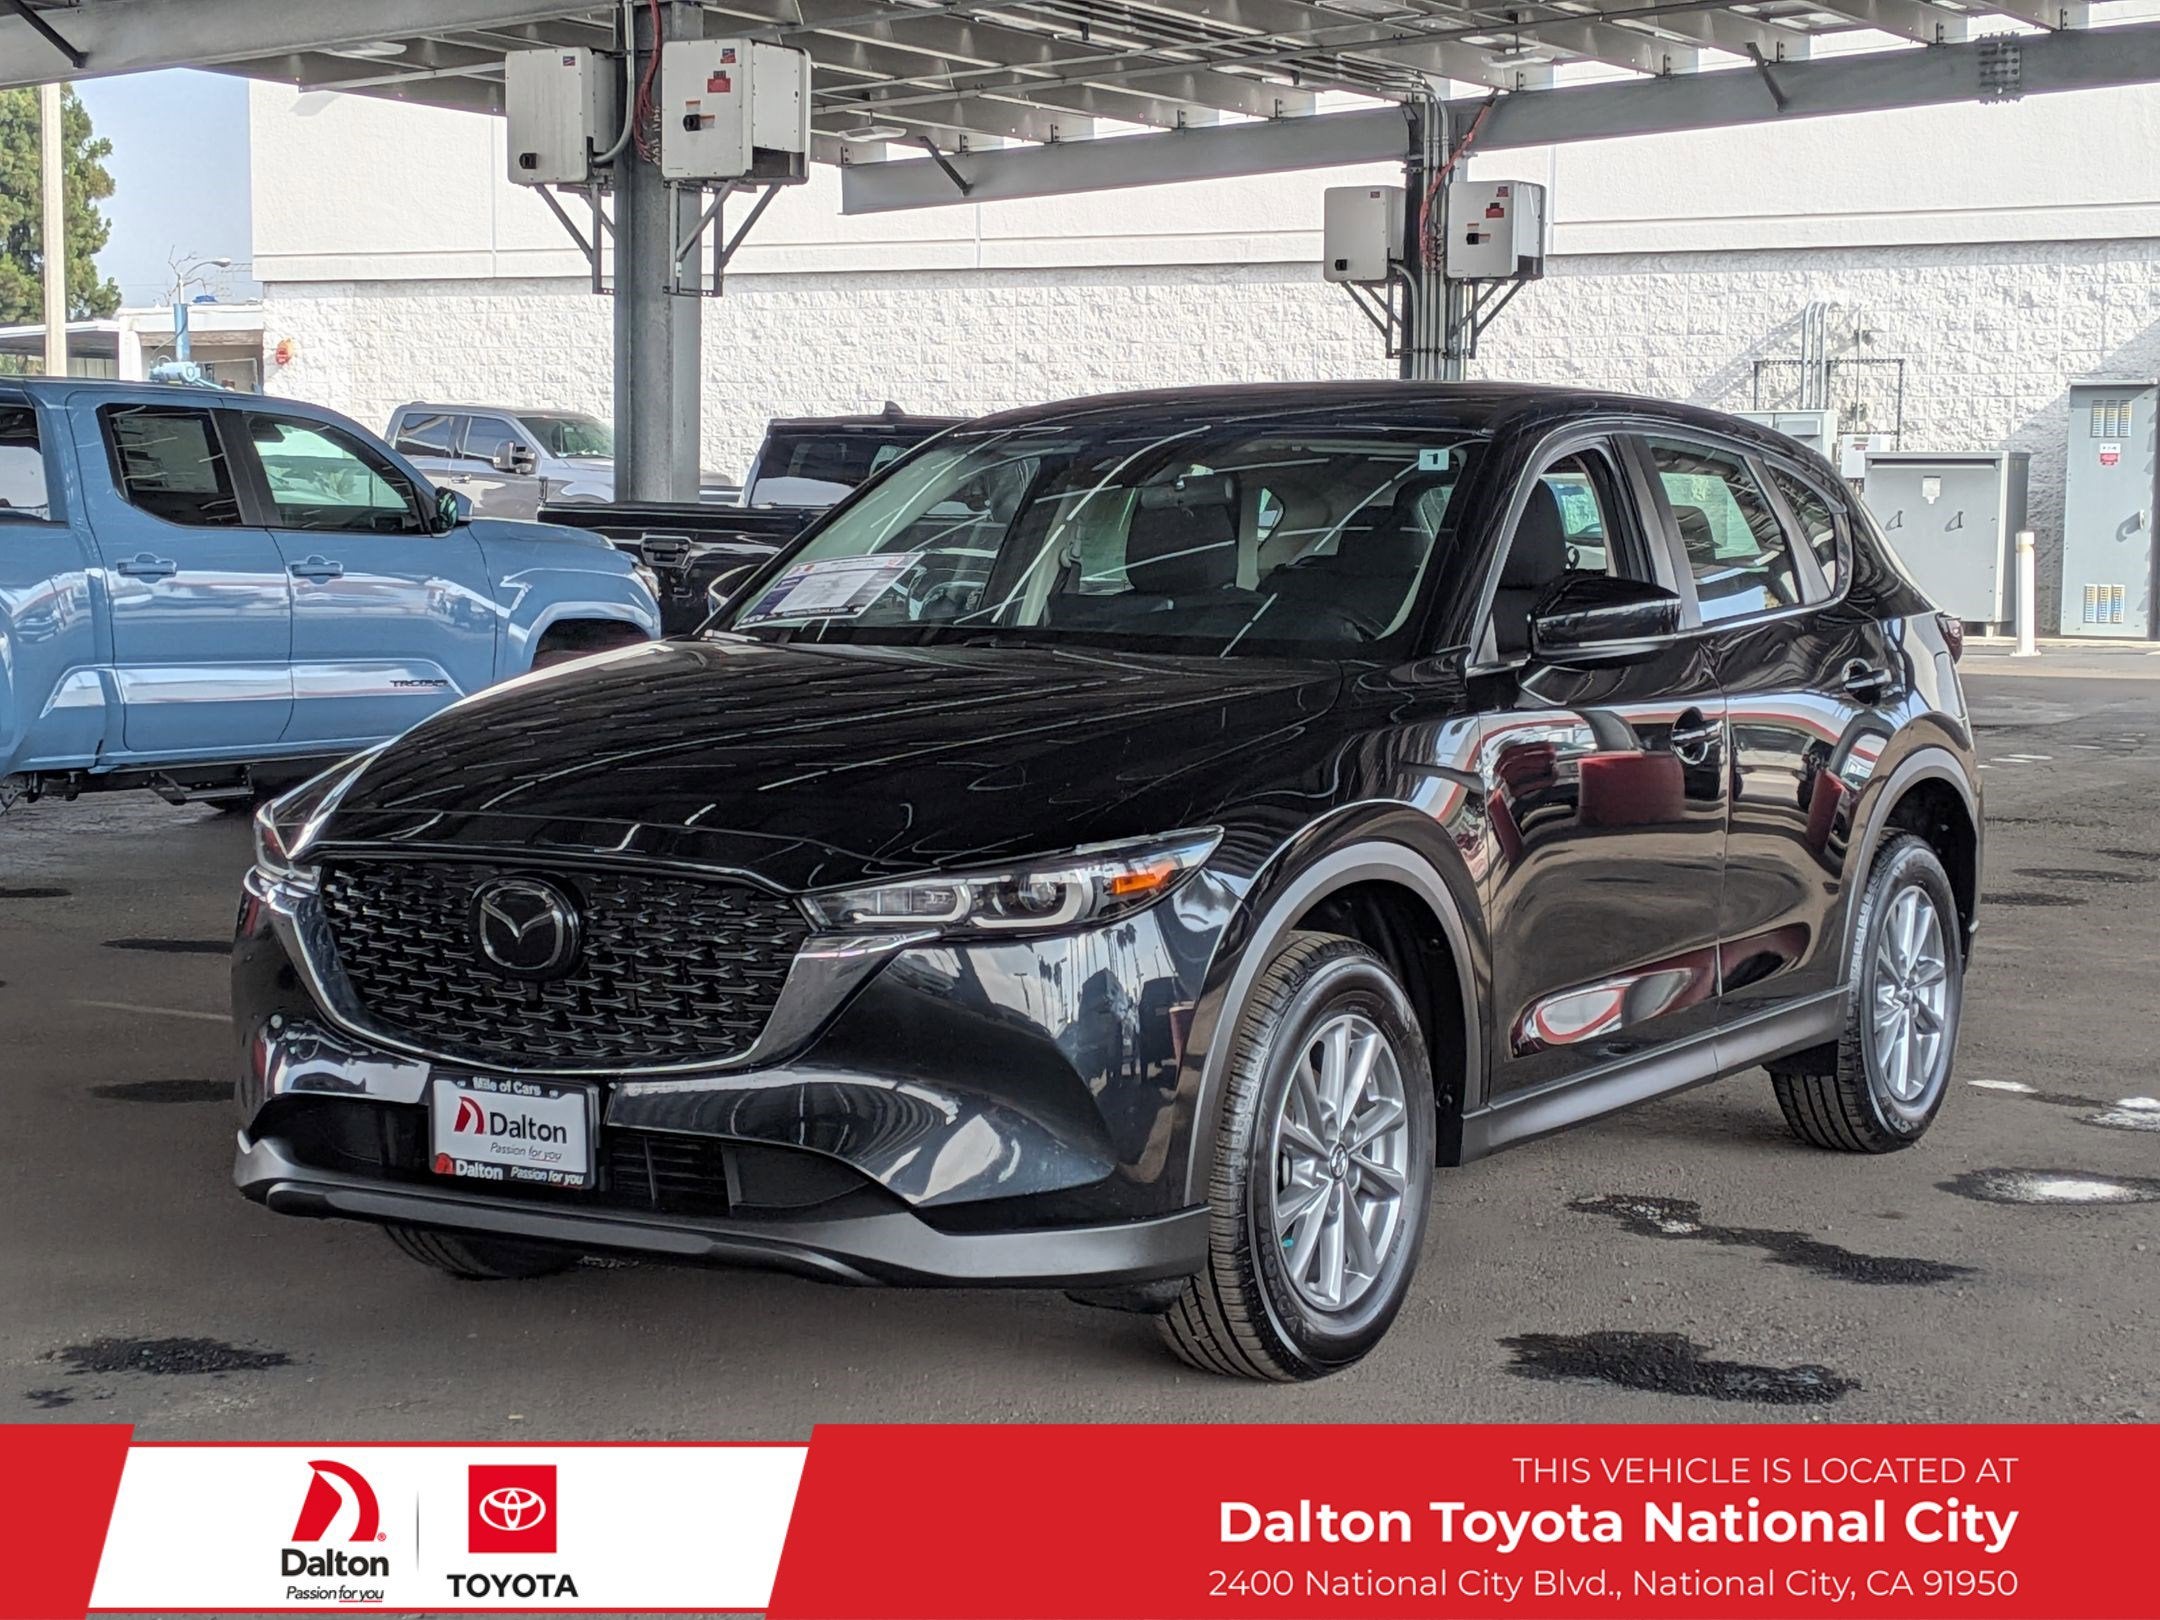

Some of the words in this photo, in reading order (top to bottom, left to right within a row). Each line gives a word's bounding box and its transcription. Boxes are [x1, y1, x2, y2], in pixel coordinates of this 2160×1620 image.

[1427, 453, 1439, 465] 1
[472, 1076, 497, 1091] Mile
[499, 1079, 511, 1093] of
[513, 1080, 542, 1096] Cars
[490, 1112, 567, 1144] Dalton
[490, 1142, 526, 1156] Passion
[528, 1146, 542, 1159] for
[543, 1151, 562, 1161] you
[455, 1159, 503, 1180] Dalton
[510, 1166, 547, 1182] Passion
[548, 1170, 562, 1183] for
[563, 1174, 584, 1186] you
